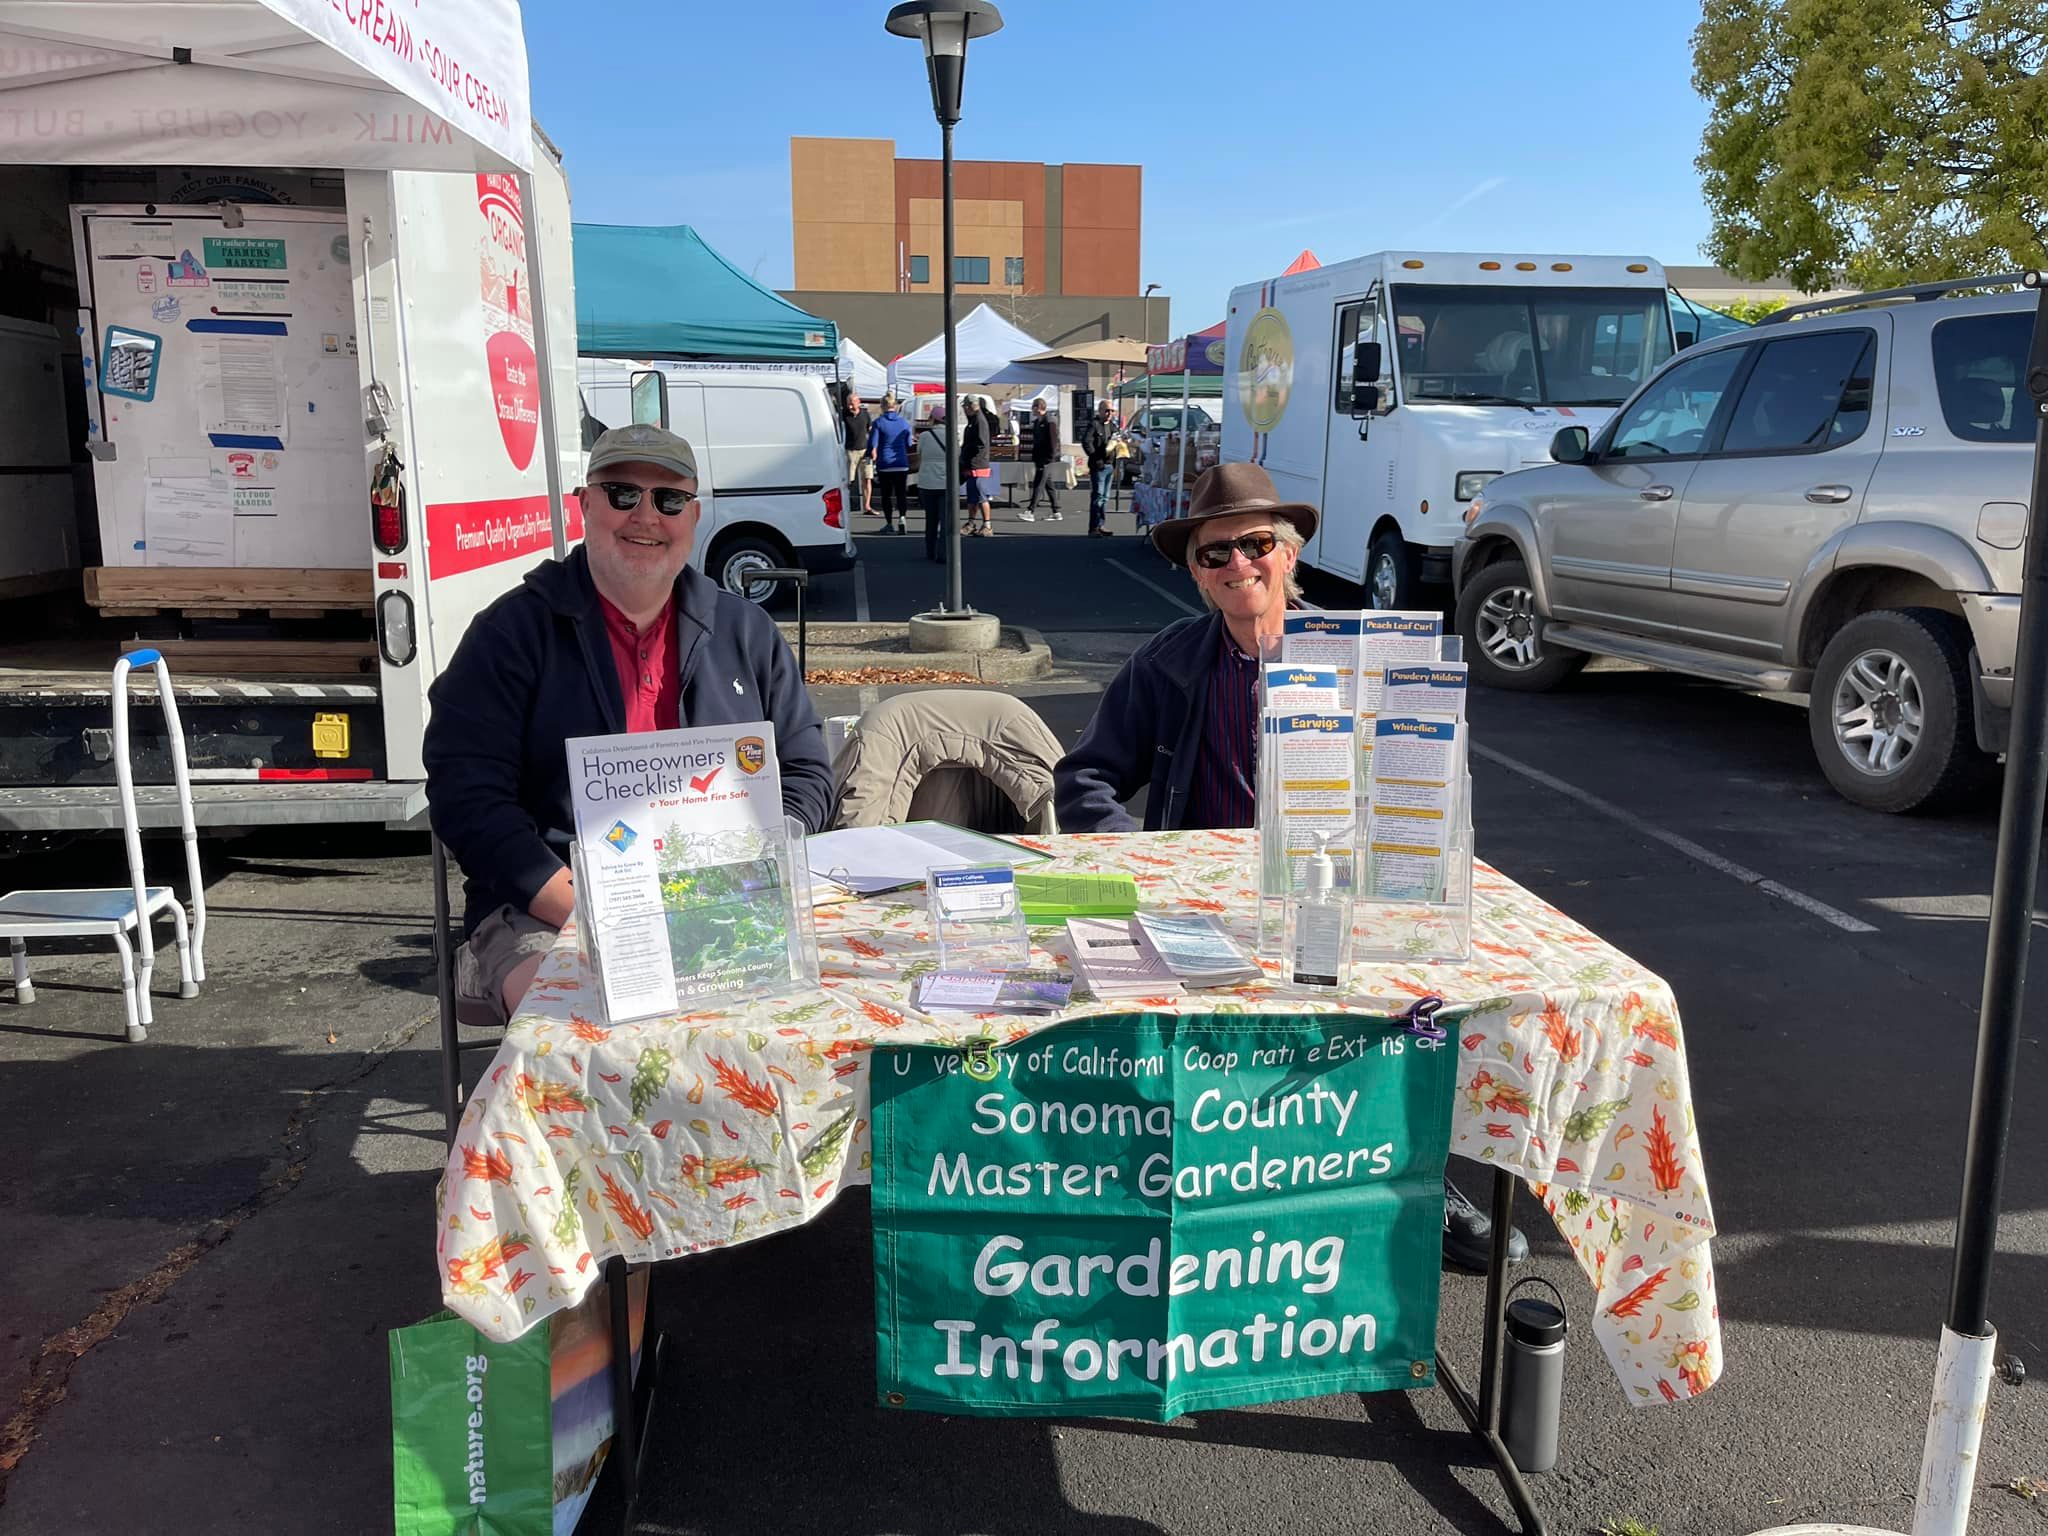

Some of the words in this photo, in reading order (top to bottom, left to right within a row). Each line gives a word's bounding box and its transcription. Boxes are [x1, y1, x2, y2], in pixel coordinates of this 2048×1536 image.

[424, 39, 463, 100] SOUR
[465, 72, 510, 131] CREAM
[221, 247, 271, 257] FARMERS
[224, 258, 268, 269] MARKET
[1891, 426, 1926, 437] SR5
[455, 523, 485, 551] Premium
[485, 519, 505, 551] Quality
[505, 516, 525, 549] Organic
[1304, 621, 1341, 631] Gophers
[1366, 621, 1392, 630] Peach
[1393, 621, 1412, 630] Leaf
[1413, 622, 1433, 631] Curl
[1288, 673, 1317, 682] Aphids
[1391, 672, 1429, 683] Powdery
[1431, 673, 1463, 682] Mildew
[1291, 716, 1339, 731] Earwigs
[1392, 722, 1438, 733] Whiteflies
[583, 751, 726, 778] Homeowners
[585, 773, 683, 801] Checklist
[659, 799, 680, 808] Your
[682, 796, 708, 805] Home
[711, 793, 727, 801] Fire
[729, 789, 749, 799] Safe
[697, 971, 716, 980] Keep
[716, 967, 746, 977] Sonoma
[747, 961, 773, 971] County
[697, 978, 744, 993] Growing
[1027, 1044, 1054, 1075] of
[1062, 1045, 1164, 1078] Californi
[971, 1093, 1171, 1137] Sonoma
[1190, 1083, 1359, 1136] County
[927, 1152, 1119, 1196] Master
[1138, 1141, 1393, 1198] Gardeners
[973, 1230, 1344, 1297] Gardening
[932, 1305, 1376, 1383] Information
[464, 1354, 488, 1505] nature.org
